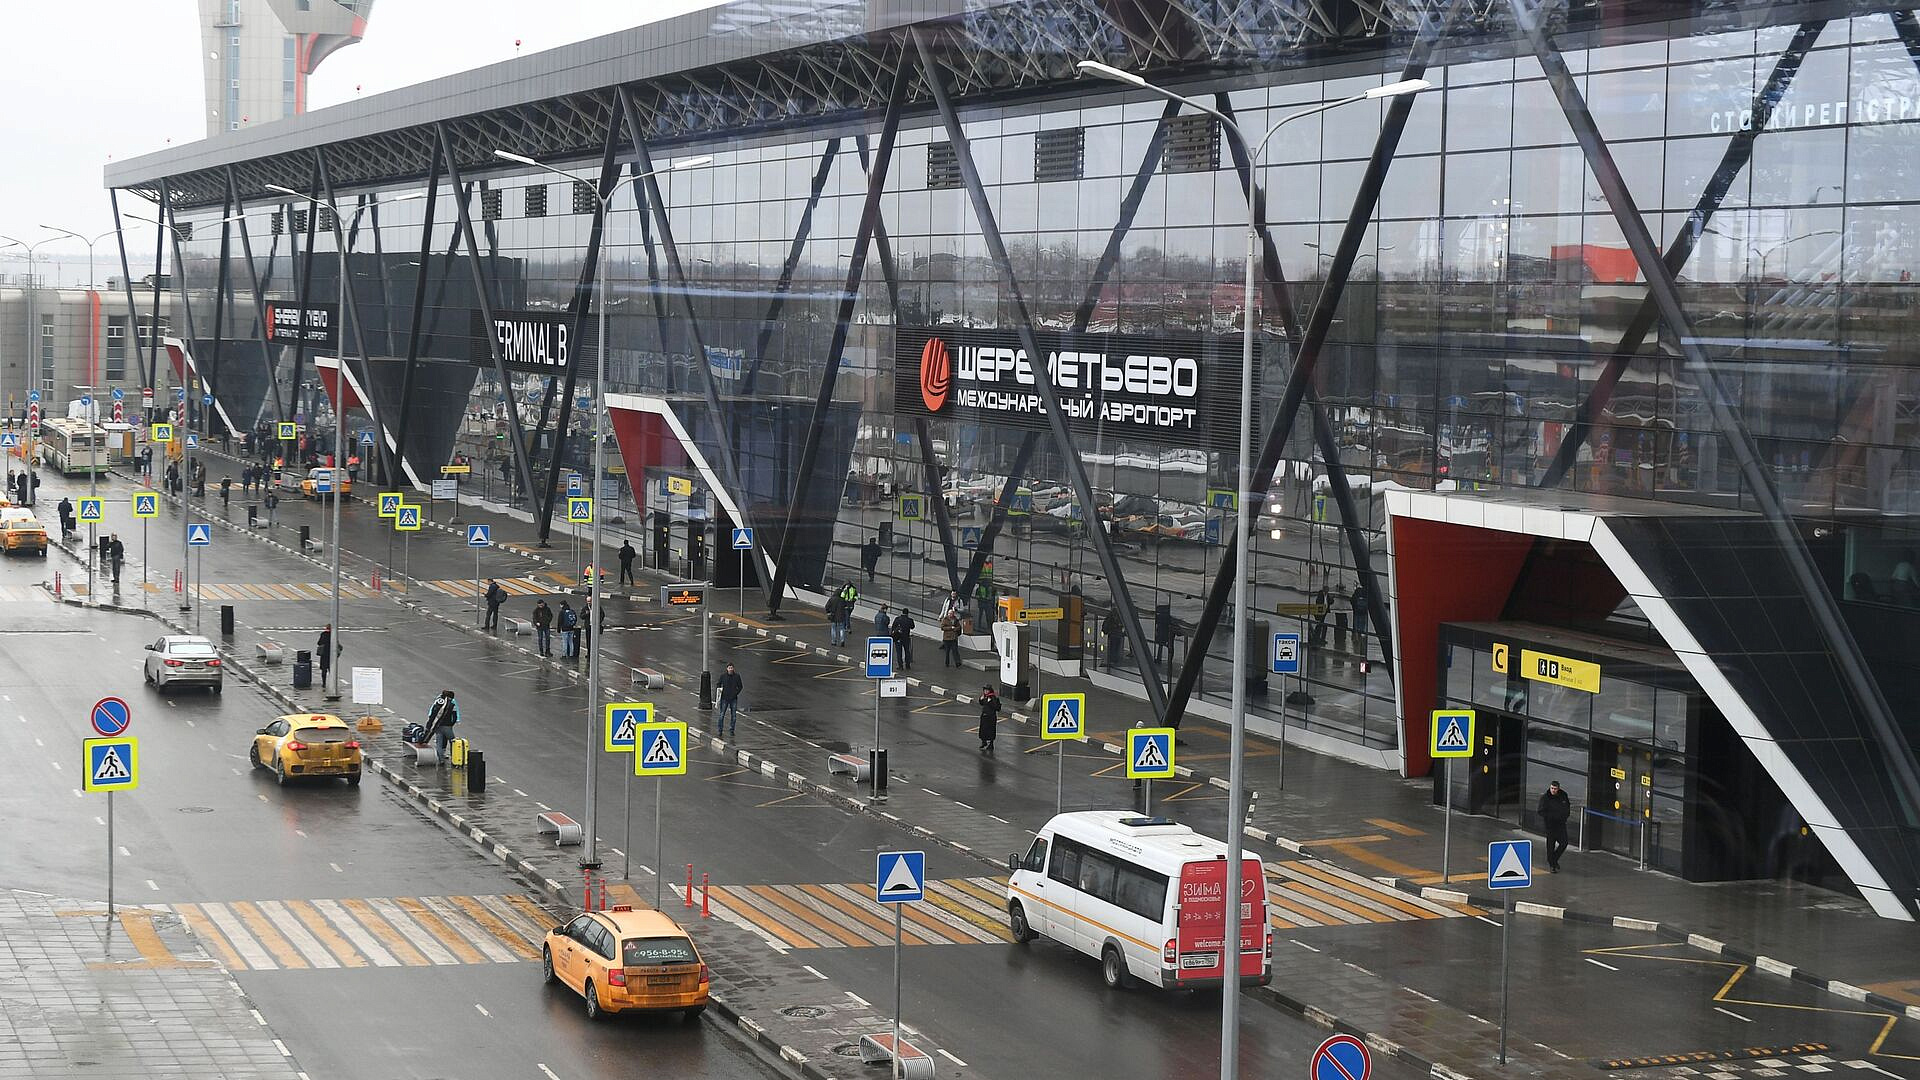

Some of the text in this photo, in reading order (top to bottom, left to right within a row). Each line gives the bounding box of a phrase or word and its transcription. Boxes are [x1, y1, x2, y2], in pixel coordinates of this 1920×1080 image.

[1710, 96, 1920, 134] СТОКИ РЕГСТР
[492, 320, 568, 367] ERMINAL B
[957, 388, 1197, 429] МЕЖДУНАРОНЫЙ АЭРОПОРТ
